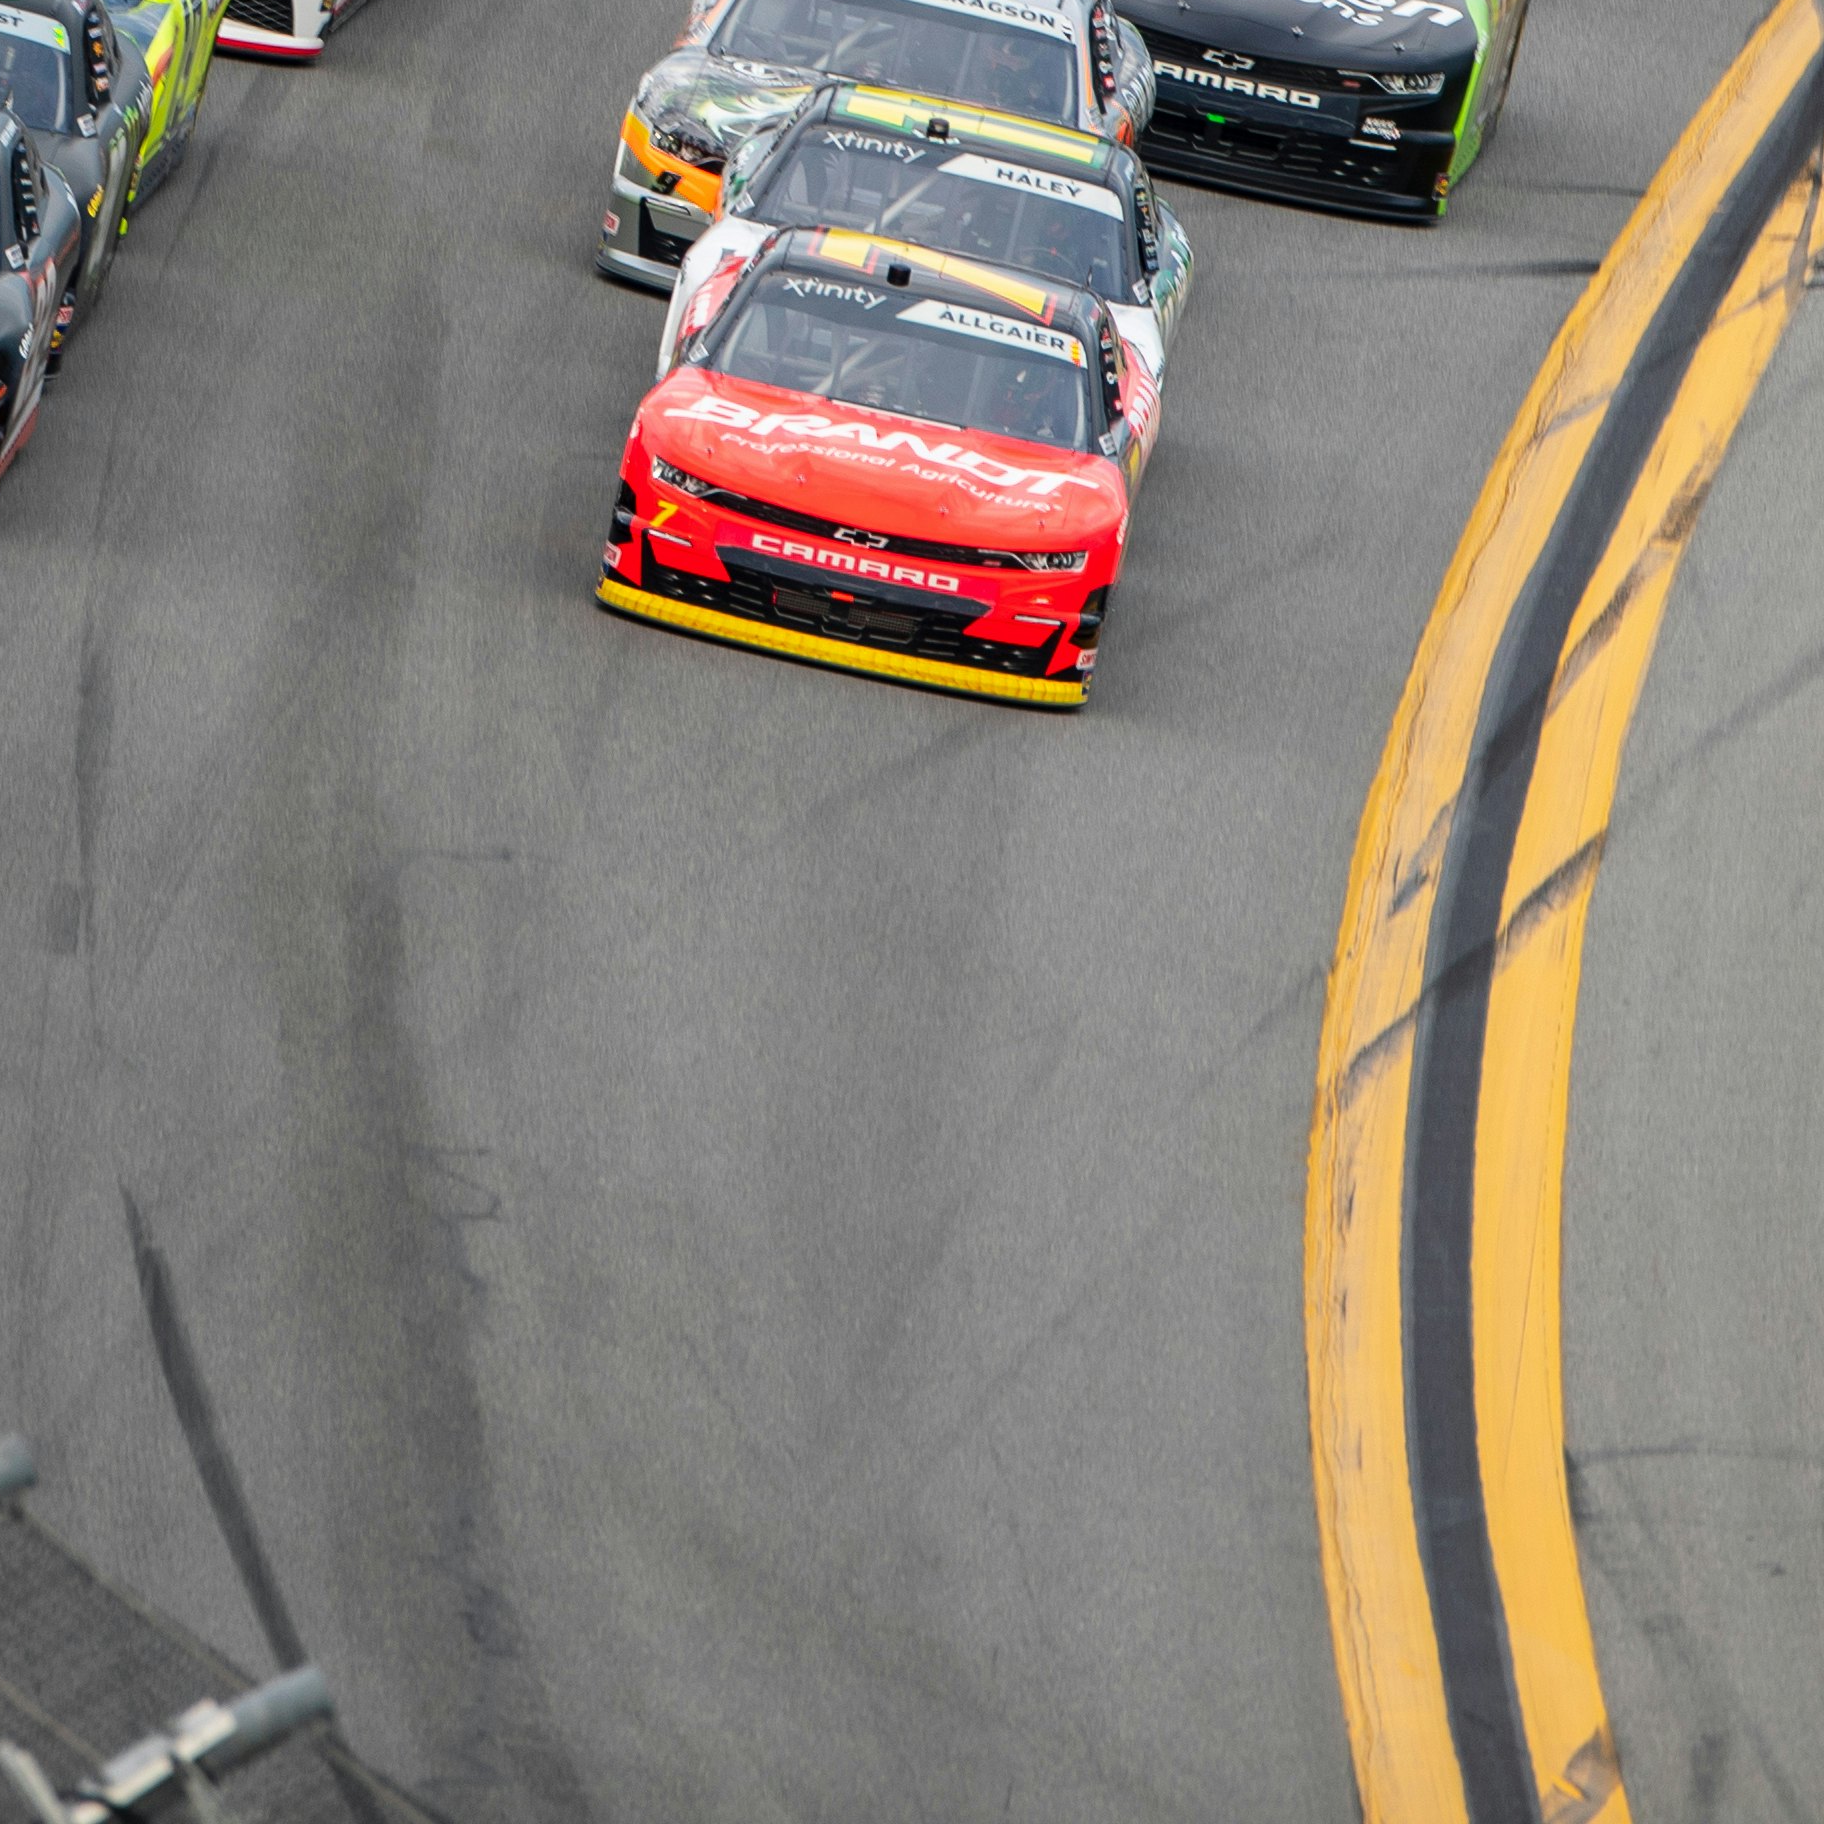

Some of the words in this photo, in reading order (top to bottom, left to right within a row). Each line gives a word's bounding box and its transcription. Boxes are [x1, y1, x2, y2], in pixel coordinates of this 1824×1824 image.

[1152, 58, 1322, 110] AMARO
[823, 131, 926, 164] xfinity
[997, 165, 1082, 200] HALEY
[783, 277, 887, 310] xfinity
[938, 307, 1066, 351] ALLGAIER
[665, 394, 1100, 498] BRANDT
[720, 431, 897, 471] Professional
[898, 462, 1056, 512] Agriculture
[650, 500, 678, 526] 7
[751, 533, 961, 592] CAMARO
